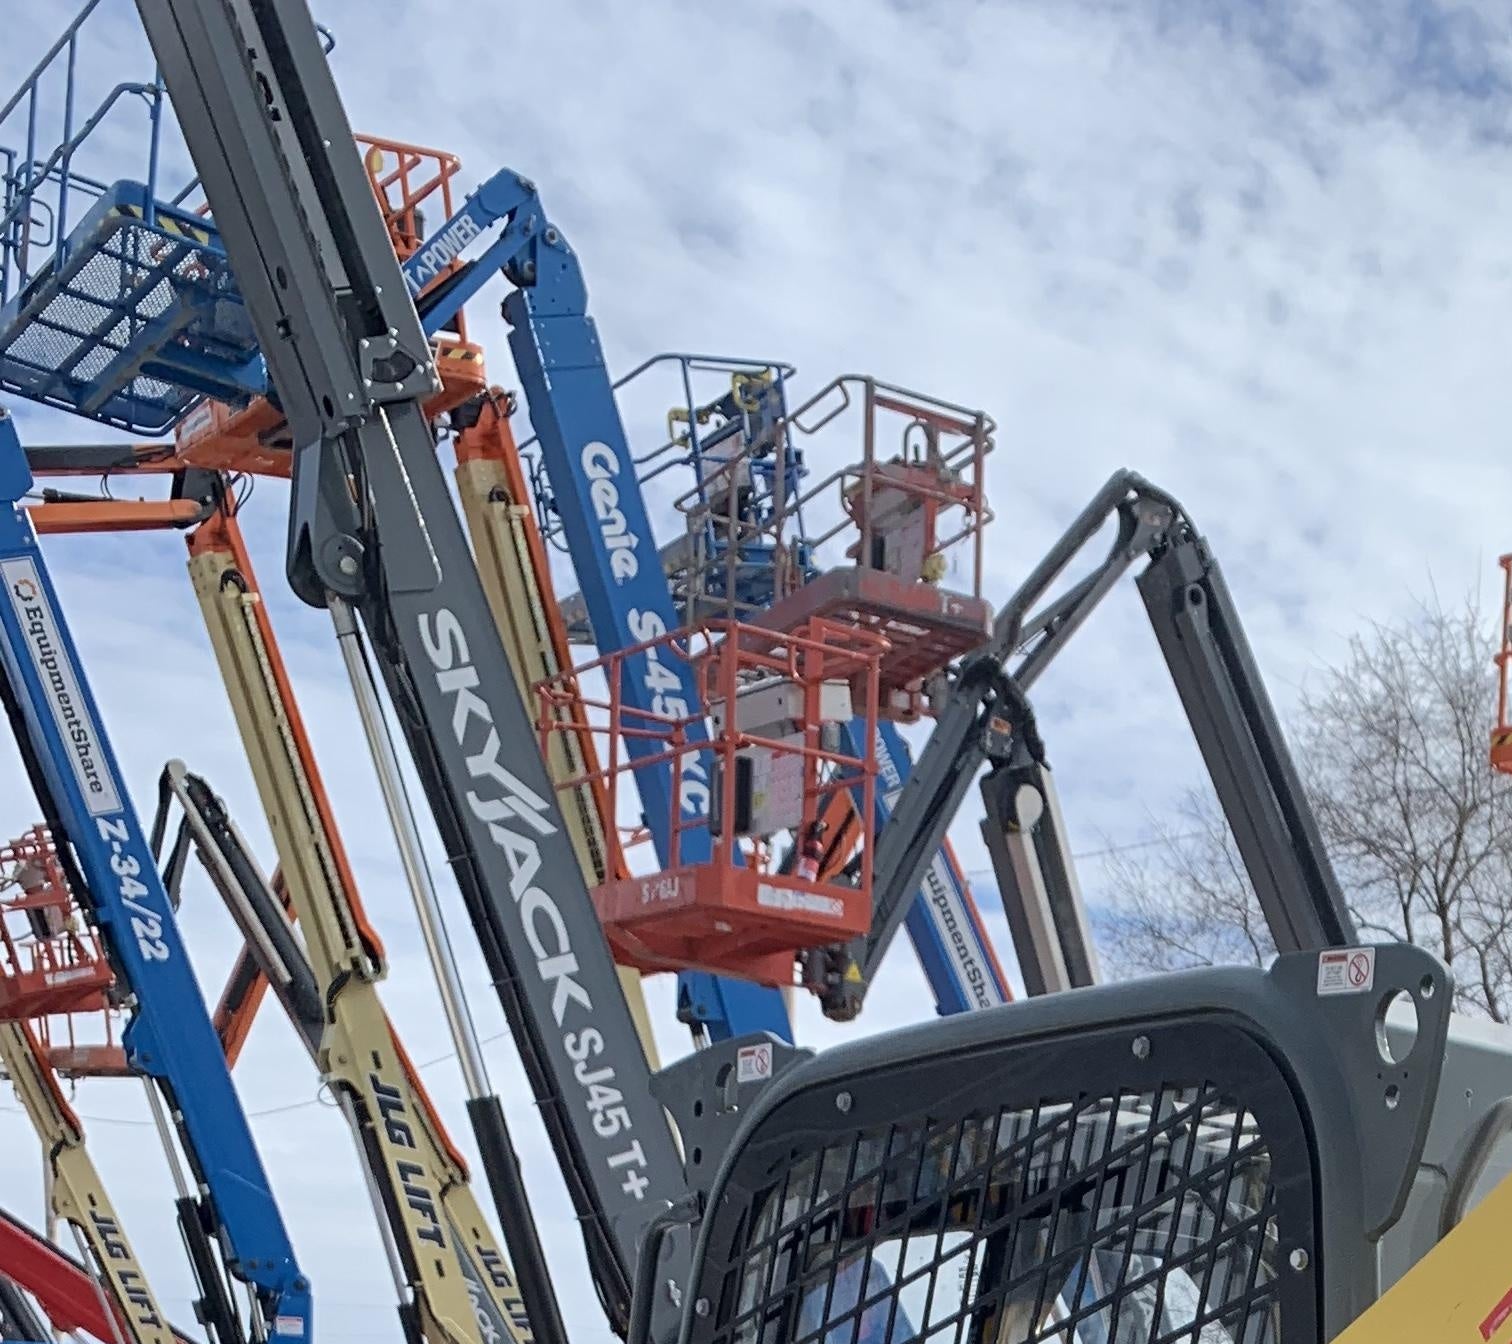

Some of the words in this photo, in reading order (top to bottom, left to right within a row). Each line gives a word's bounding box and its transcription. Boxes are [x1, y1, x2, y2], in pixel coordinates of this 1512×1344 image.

[581, 440, 639, 586] Genie
[24, 605, 103, 794] EquipmentShare
[96, 818, 170, 962] Z-34/22
[418, 606, 594, 1028] SKYJACK
[564, 1028, 633, 1139] SJ45
[607, 1139, 650, 1201] T+
[370, 1073, 416, 1150] JLG
[397, 1159, 447, 1249] LIFT
[90, 1209, 130, 1260] JLG
[117, 1269, 162, 1329] LIFT
[475, 1244, 513, 1288] JLG
